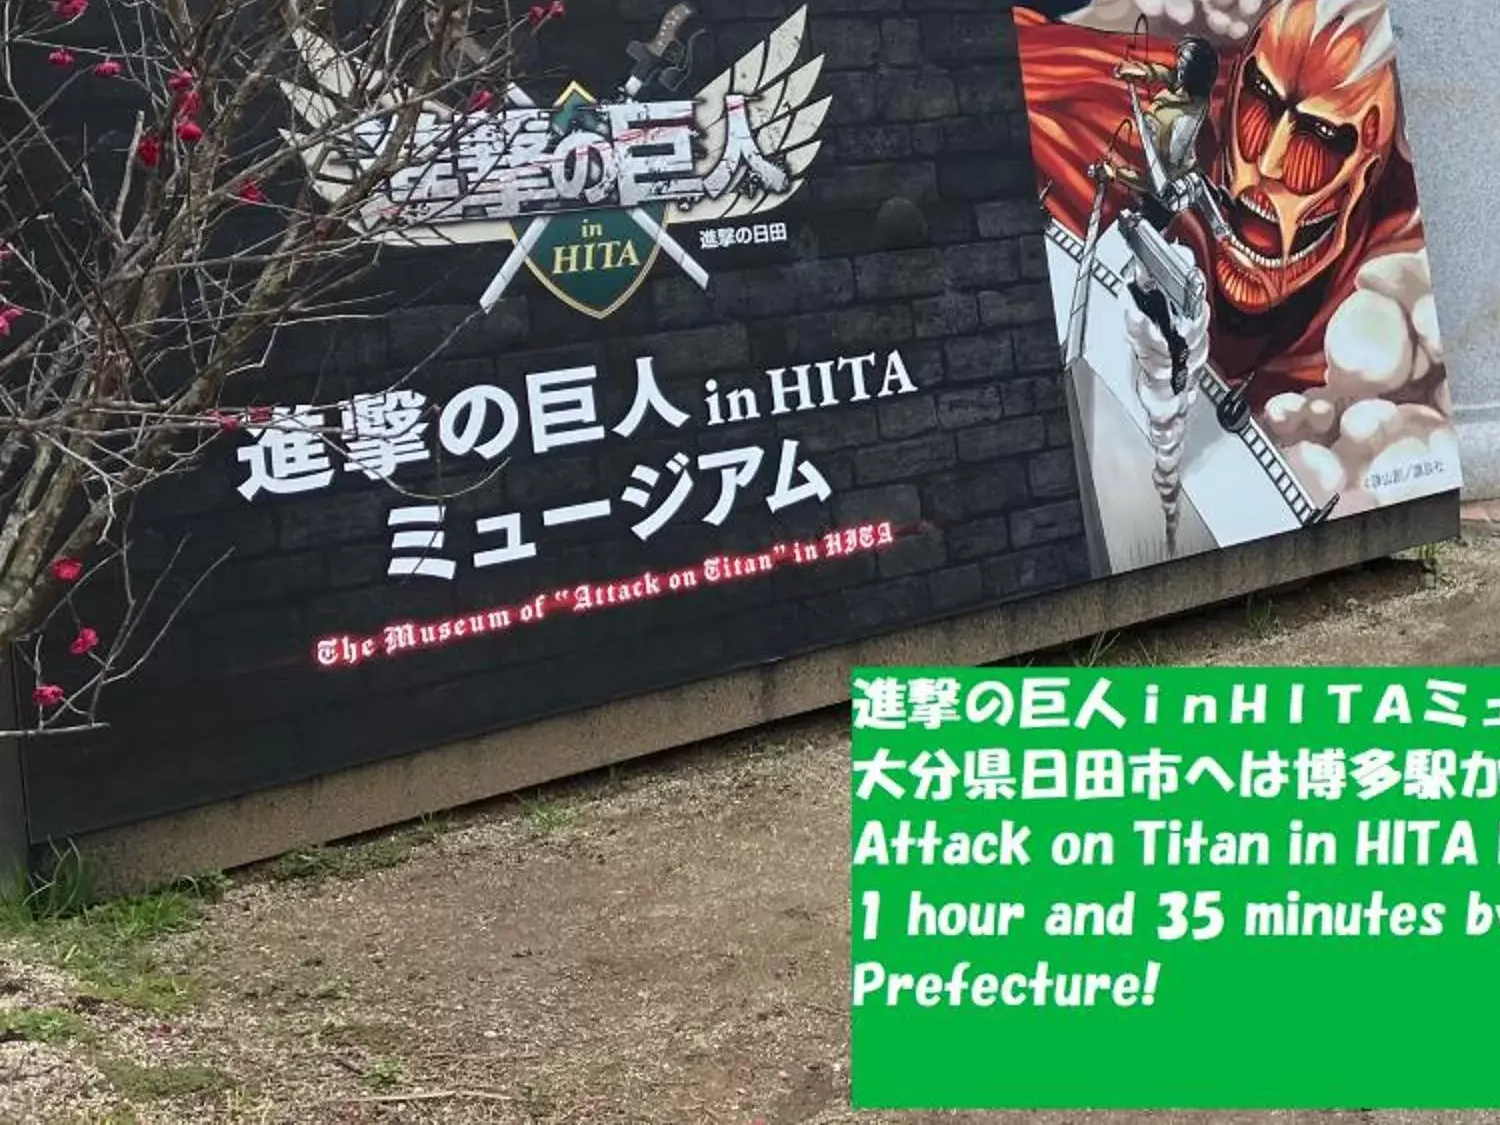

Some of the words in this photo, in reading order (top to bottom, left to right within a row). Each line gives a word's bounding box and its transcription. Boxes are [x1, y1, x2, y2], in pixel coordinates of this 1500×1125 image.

[551, 239, 642, 276] HITA
[581, 218, 604, 238] in
[699, 222, 788, 250] 進撃の日田
[236, 356, 691, 501] 進撃の巨人
[704, 378, 761, 426] in
[767, 350, 918, 416] HITA
[387, 439, 833, 580] ミュージアム
[317, 636, 376, 665] The
[383, 609, 511, 655] Museum
[519, 594, 546, 621] of
[668, 568, 698, 590] on
[792, 541, 818, 563] in
[822, 522, 895, 558] HITA
